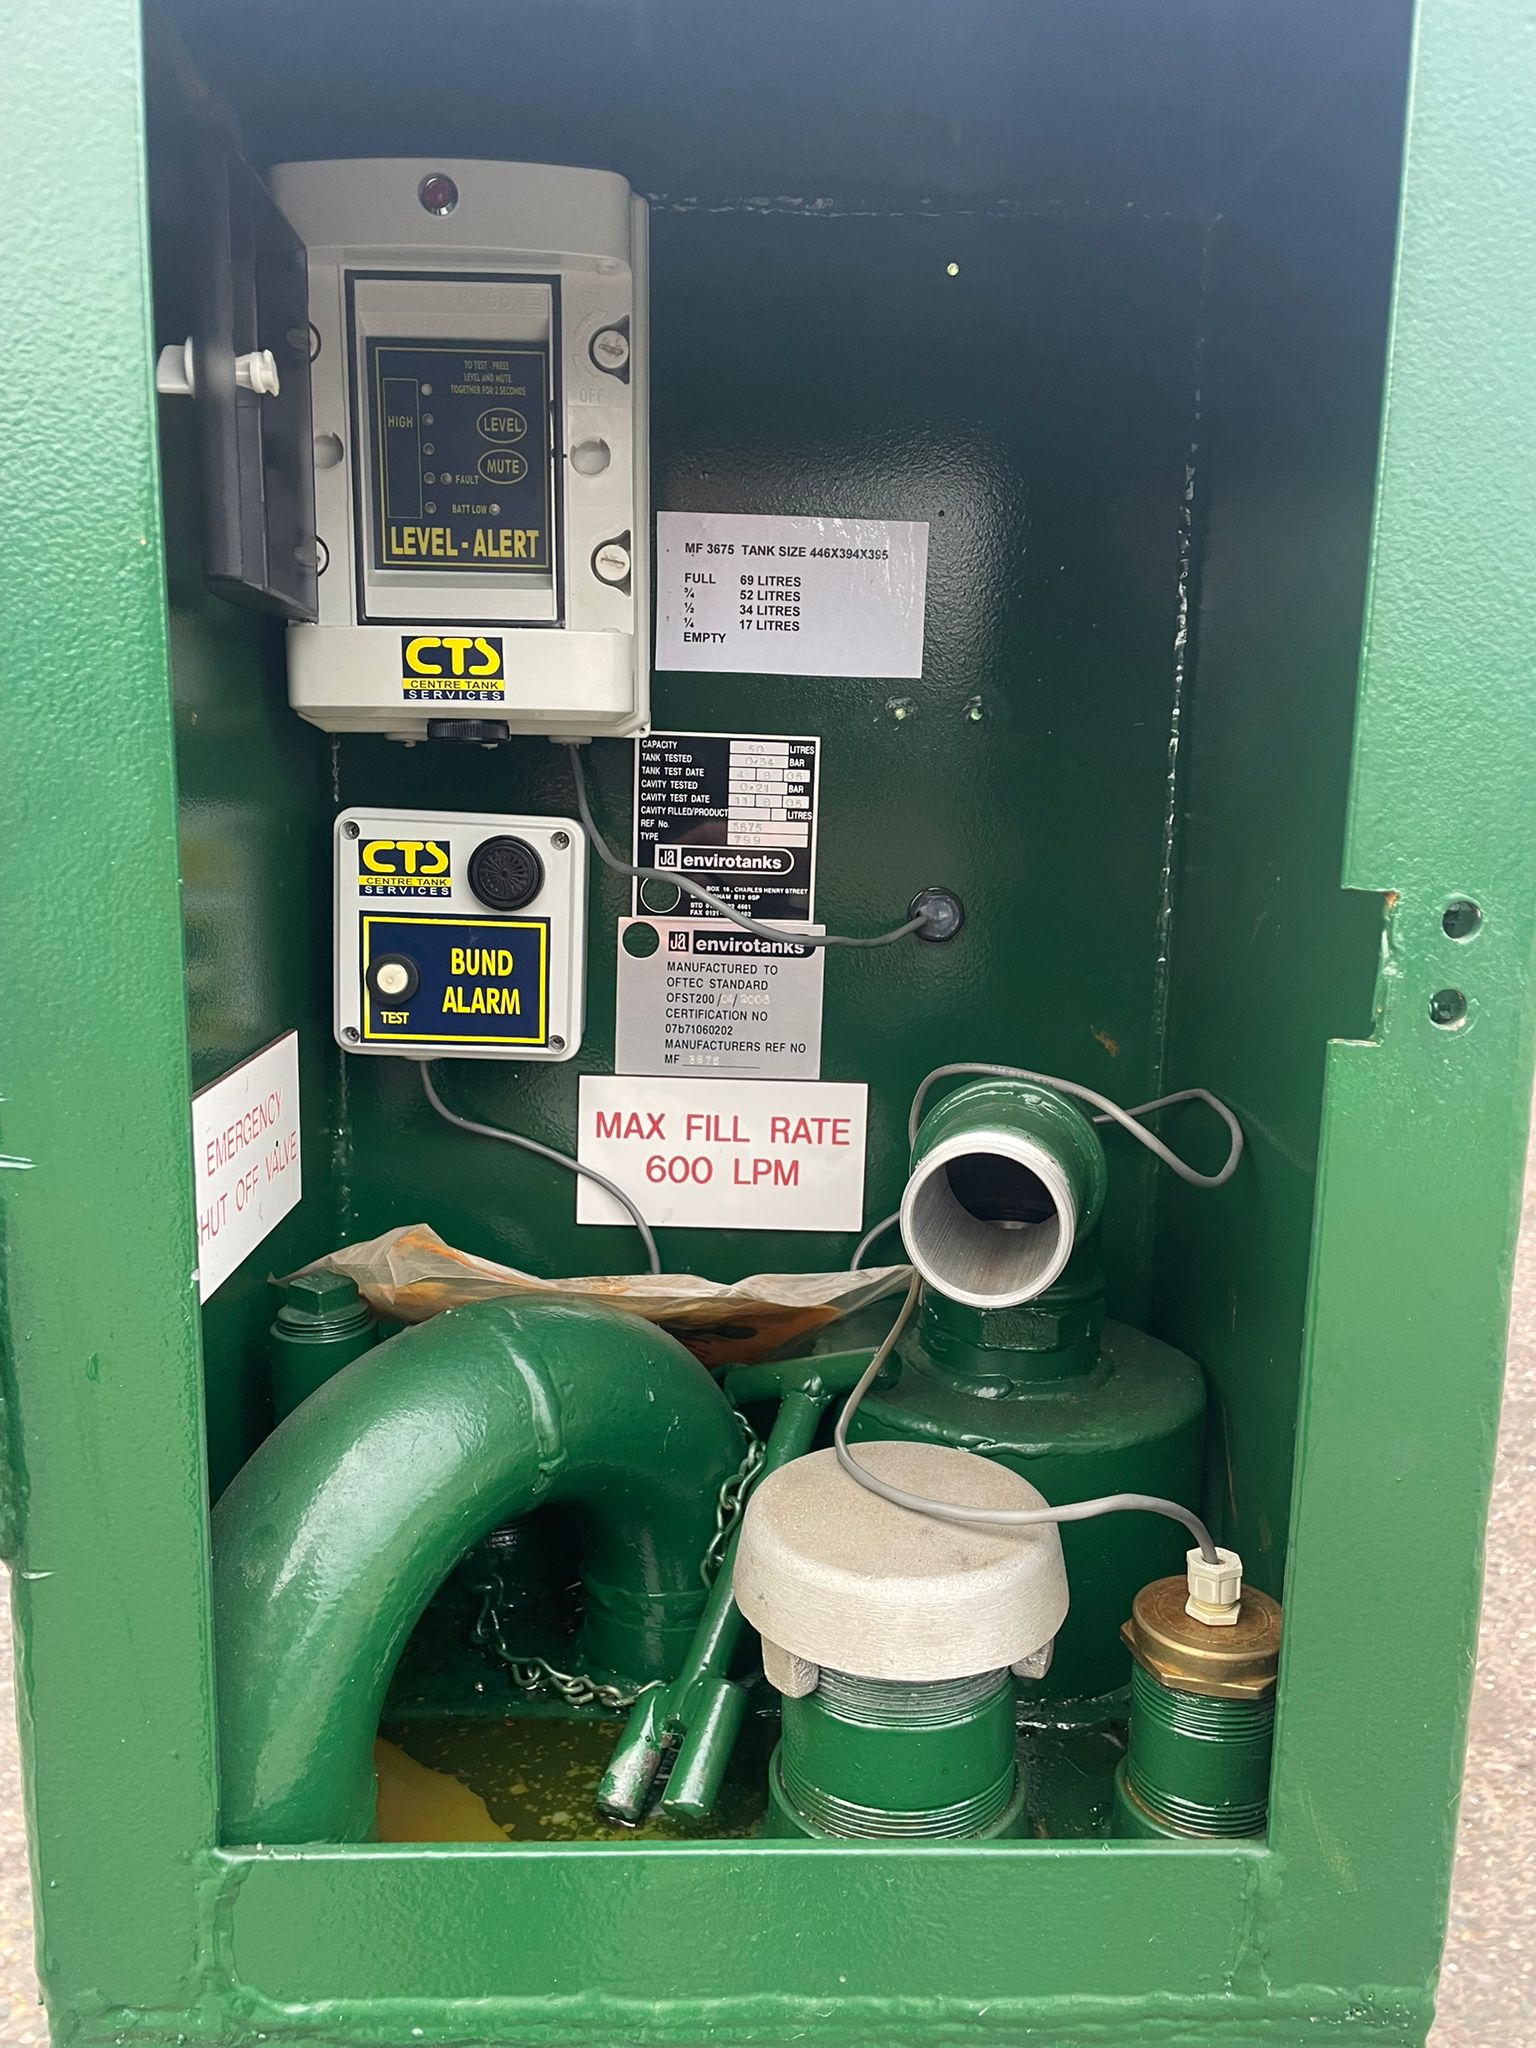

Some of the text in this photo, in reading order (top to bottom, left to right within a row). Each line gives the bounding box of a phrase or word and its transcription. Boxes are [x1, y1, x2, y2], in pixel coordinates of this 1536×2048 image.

[464, 360, 473, 369] TO
[474, 360, 487, 370] TEST
[492, 361, 509, 370] PRESS
[464, 374, 480, 382] LEVEL
[496, 375, 512, 383] MUTE
[450, 385, 526, 396] TOGETHER FOR 2 SECONDS
[388, 415, 413, 428] HIGH
[484, 417, 522, 432] LEVEL
[487, 459, 519, 473] MUTE
[456, 475, 479, 484] FAULT
[453, 504, 487, 514] BATT LOW
[391, 526, 458, 558] LEVEL
[473, 529, 539, 558] ALERT
[685, 542, 889, 560] MF 3675 TANK SIZE 446X394X395
[684, 573, 801, 587] FULL 69 LITRES
[740, 590, 754, 600] 52
[758, 590, 801, 602] LITRES
[740, 604, 753, 615] 34
[757, 605, 800, 617] LITRES
[740, 620, 752, 630] 17
[756, 620, 800, 632] LITRES
[684, 633, 726, 644] EMPTY
[406, 637, 501, 675] CTS
[410, 679, 498, 690] CENTRE TANK
[408, 689, 501, 700] SERVICES
[642, 740, 677, 749] CAPACITY
[790, 746, 815, 754] LITRES
[642, 754, 661, 762] TANK
[665, 755, 692, 763] TESTED
[789, 759, 805, 767] BAR
[642, 767, 661, 775] TANK
[665, 768, 682, 776] TEST
[641, 780, 666, 788] CAVITY
[670, 781, 698, 789] TESTED
[789, 785, 804, 793] BAR
[641, 793, 666, 801] CAVITY
[670, 794, 687, 802] TEST
[691, 795, 710, 803] DATE
[641, 806, 812, 820] CAVITY FILLED/PRODUCT LITRES
[641, 820, 655, 828] REF
[641, 833, 659, 841] TYPE
[362, 841, 449, 874] CTS
[683, 854, 782, 870] envirotanks
[366, 877, 447, 886] CENTRE TANK
[365, 886, 449, 896] SERVICES
[696, 938, 805, 955] envirotanks
[451, 948, 513, 976] BUND
[667, 962, 778, 975] MANUFACTURED TO
[667, 977, 768, 990] OFTEC STANDARD
[442, 985, 521, 1015] ALARM
[380, 1011, 409, 1024] TEST
[666, 1008, 767, 1021] CERTIFICATION NO
[665, 1025, 733, 1036] 07b71060202
[665, 1039, 806, 1053] MANUFACTURERS REF NO
[665, 1055, 680, 1064] MF
[207, 1088, 284, 1177] EMERGENCY
[596, 1111, 851, 1146] MAX FILL RATE
[646, 1155, 799, 1186] 600 LPM
[199, 1130, 297, 1247] HUT OFF VALVE
